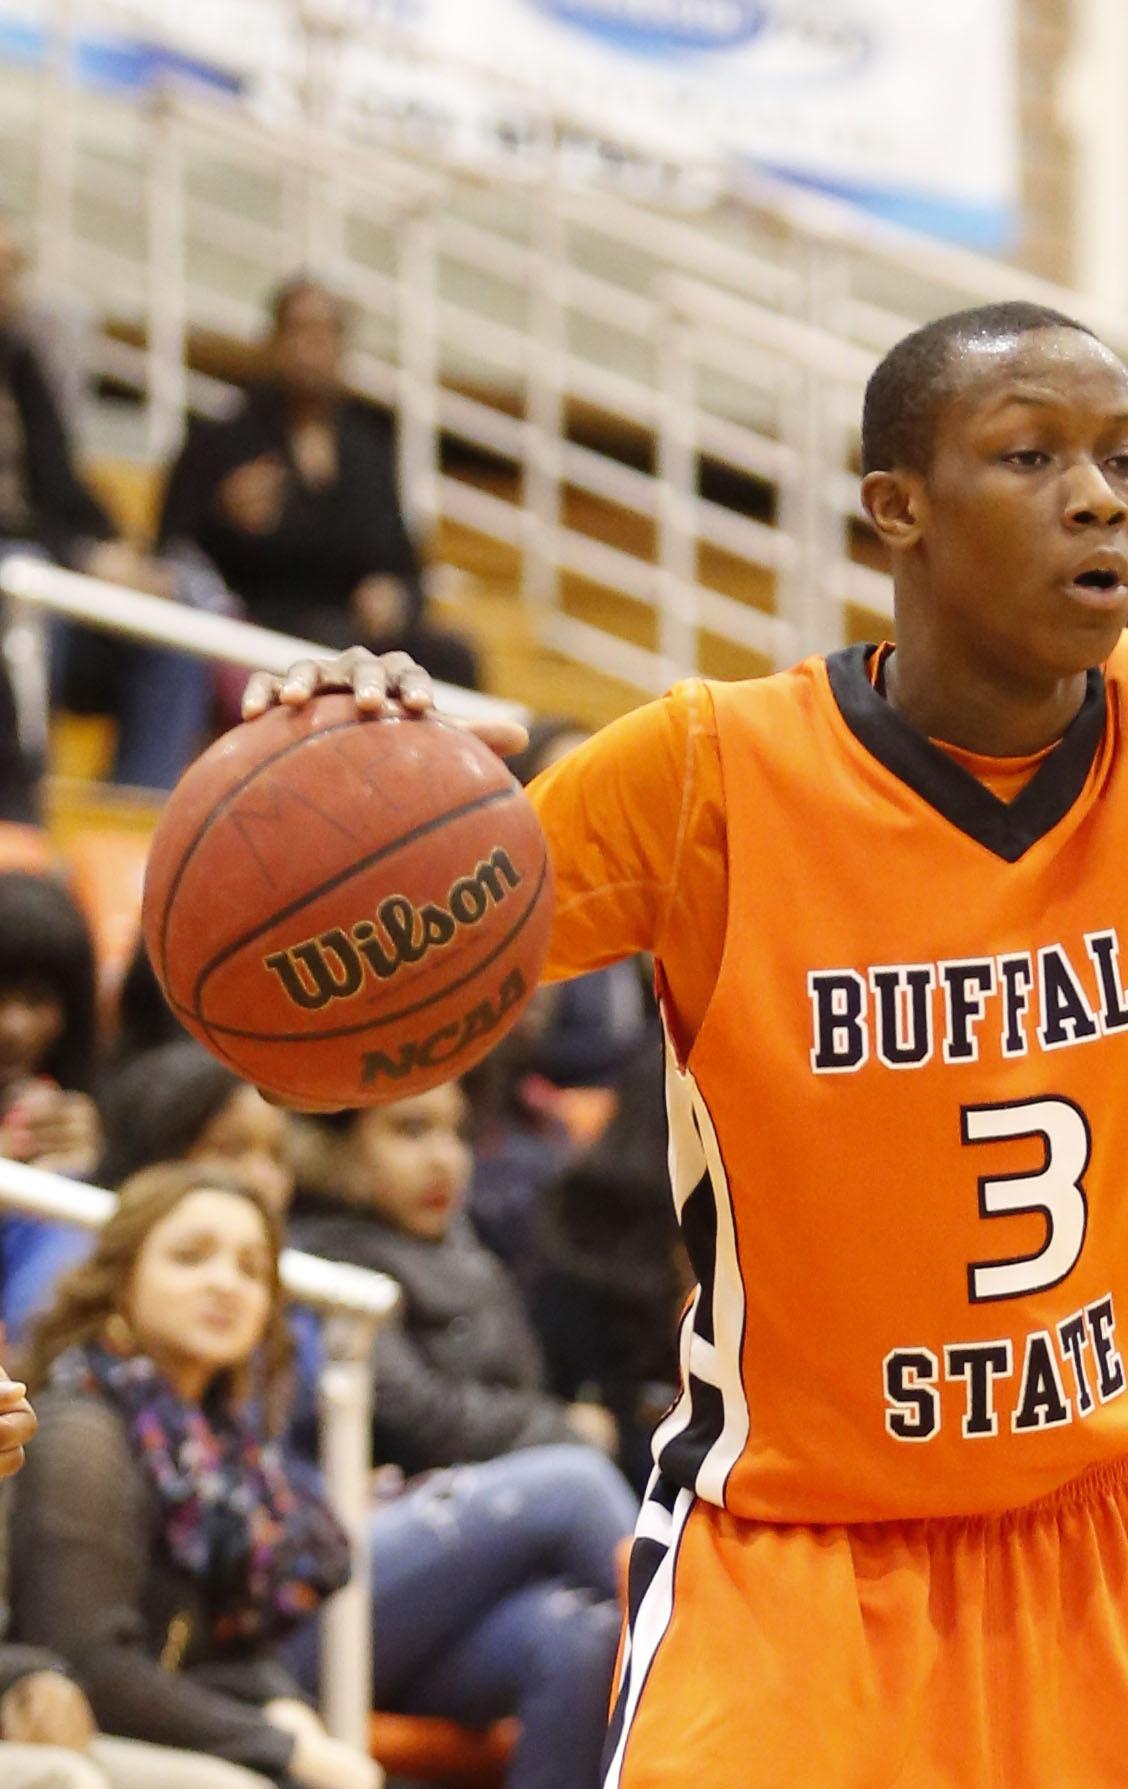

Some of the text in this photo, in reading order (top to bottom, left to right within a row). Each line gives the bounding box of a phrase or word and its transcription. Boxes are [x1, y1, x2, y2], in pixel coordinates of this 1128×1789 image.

[263, 847, 520, 1010] Wilson
[361, 968, 524, 1086] NCAA
[960, 1094, 1091, 1303] 3
[881, 1292, 1126, 1443] STATE
